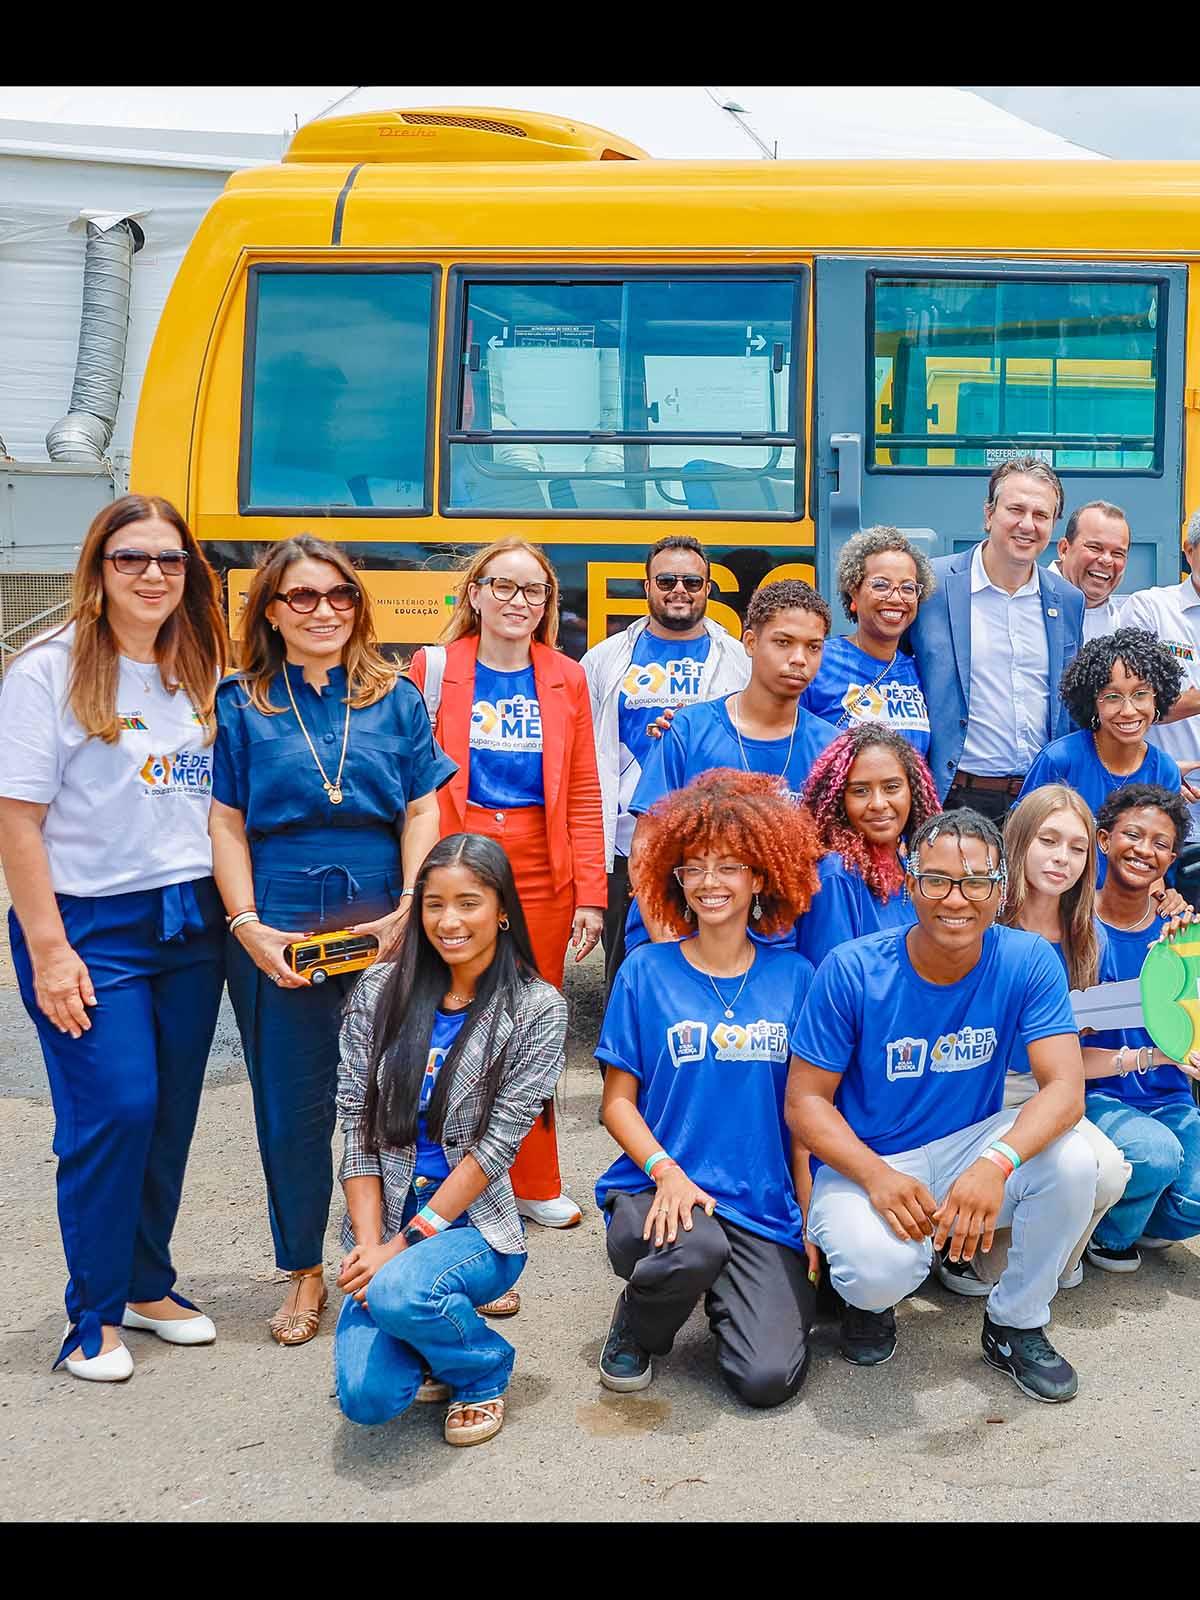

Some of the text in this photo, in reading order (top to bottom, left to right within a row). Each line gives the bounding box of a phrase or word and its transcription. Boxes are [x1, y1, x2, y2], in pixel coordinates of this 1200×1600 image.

[377, 598, 425, 606] MINISTÉRIO
[395, 608, 439, 616] EDUCAÇÃO
[172, 767, 212, 787] MEIA
